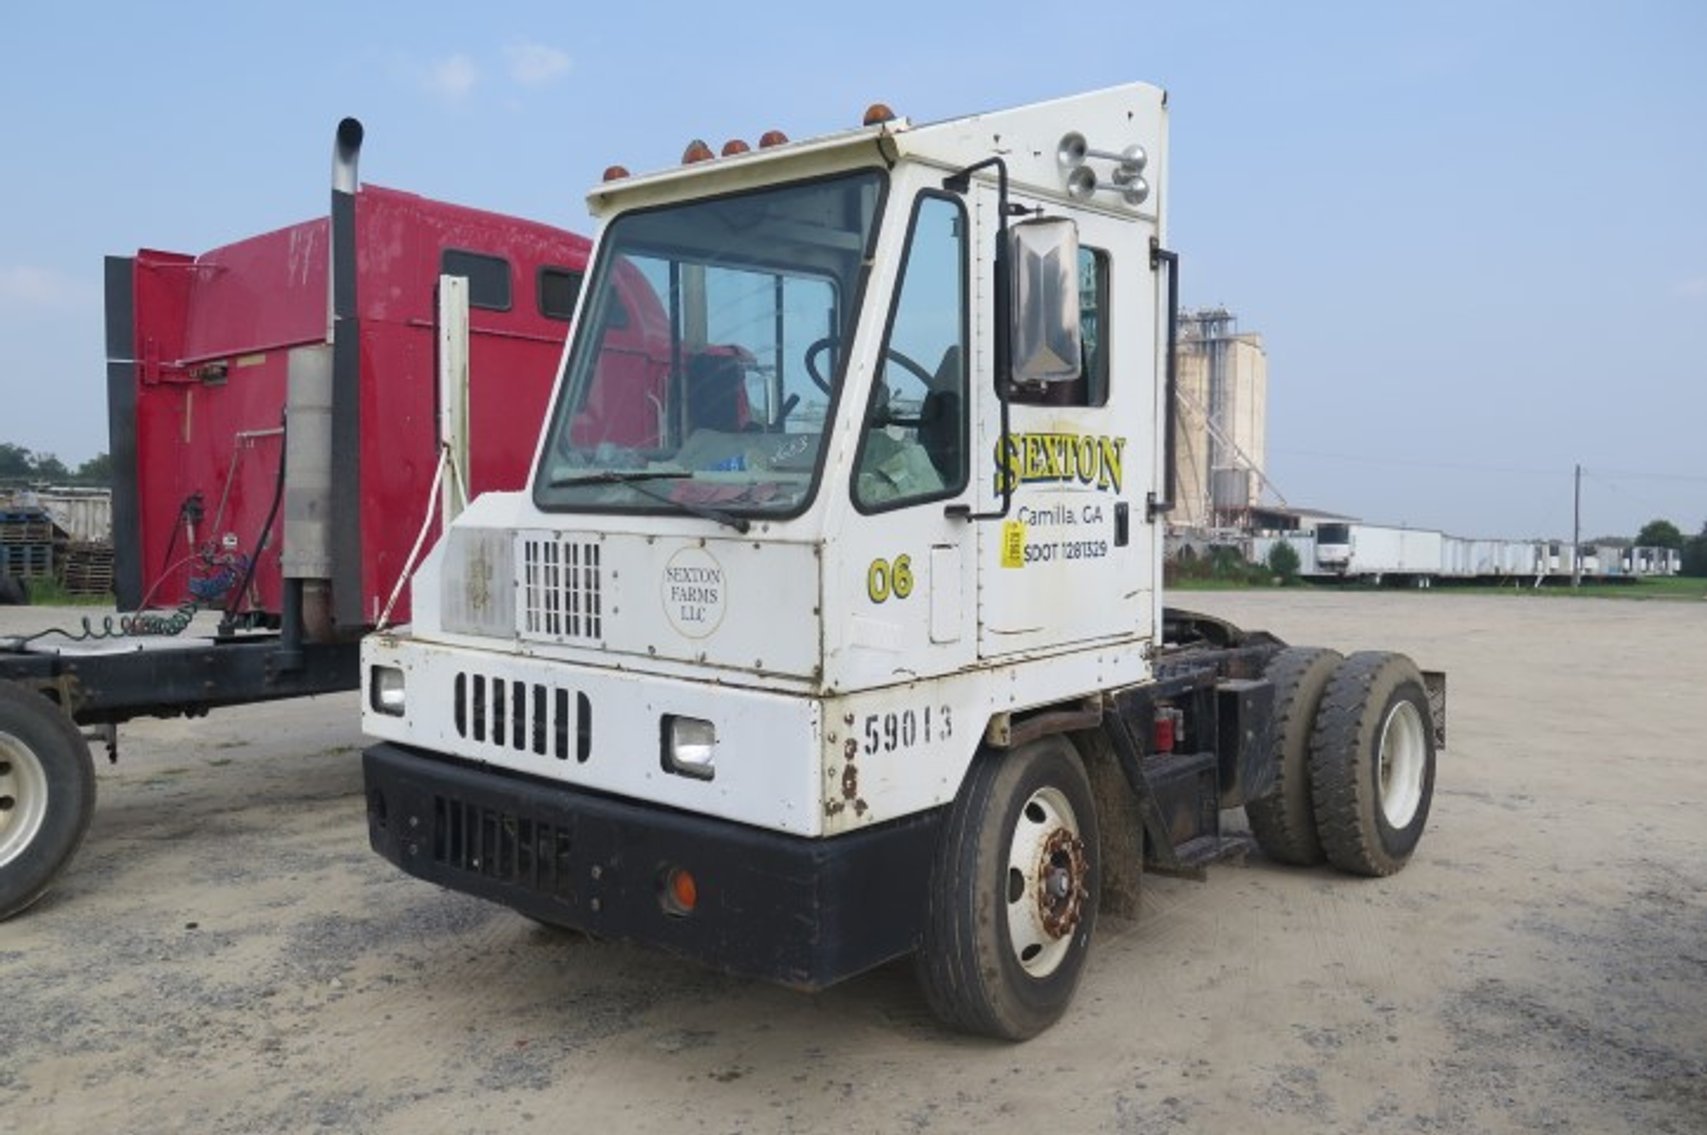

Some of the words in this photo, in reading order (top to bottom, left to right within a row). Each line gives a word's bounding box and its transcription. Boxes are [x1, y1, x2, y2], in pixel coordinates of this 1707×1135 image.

[993, 433, 1126, 498] SEXTON
[1023, 543, 1058, 562] SDOT
[666, 567, 721, 584] SEXTON
[868, 554, 914, 604] 06
[671, 586, 718, 604] FARMS
[681, 605, 706, 622] LLC
[865, 705, 953, 756] 59013
